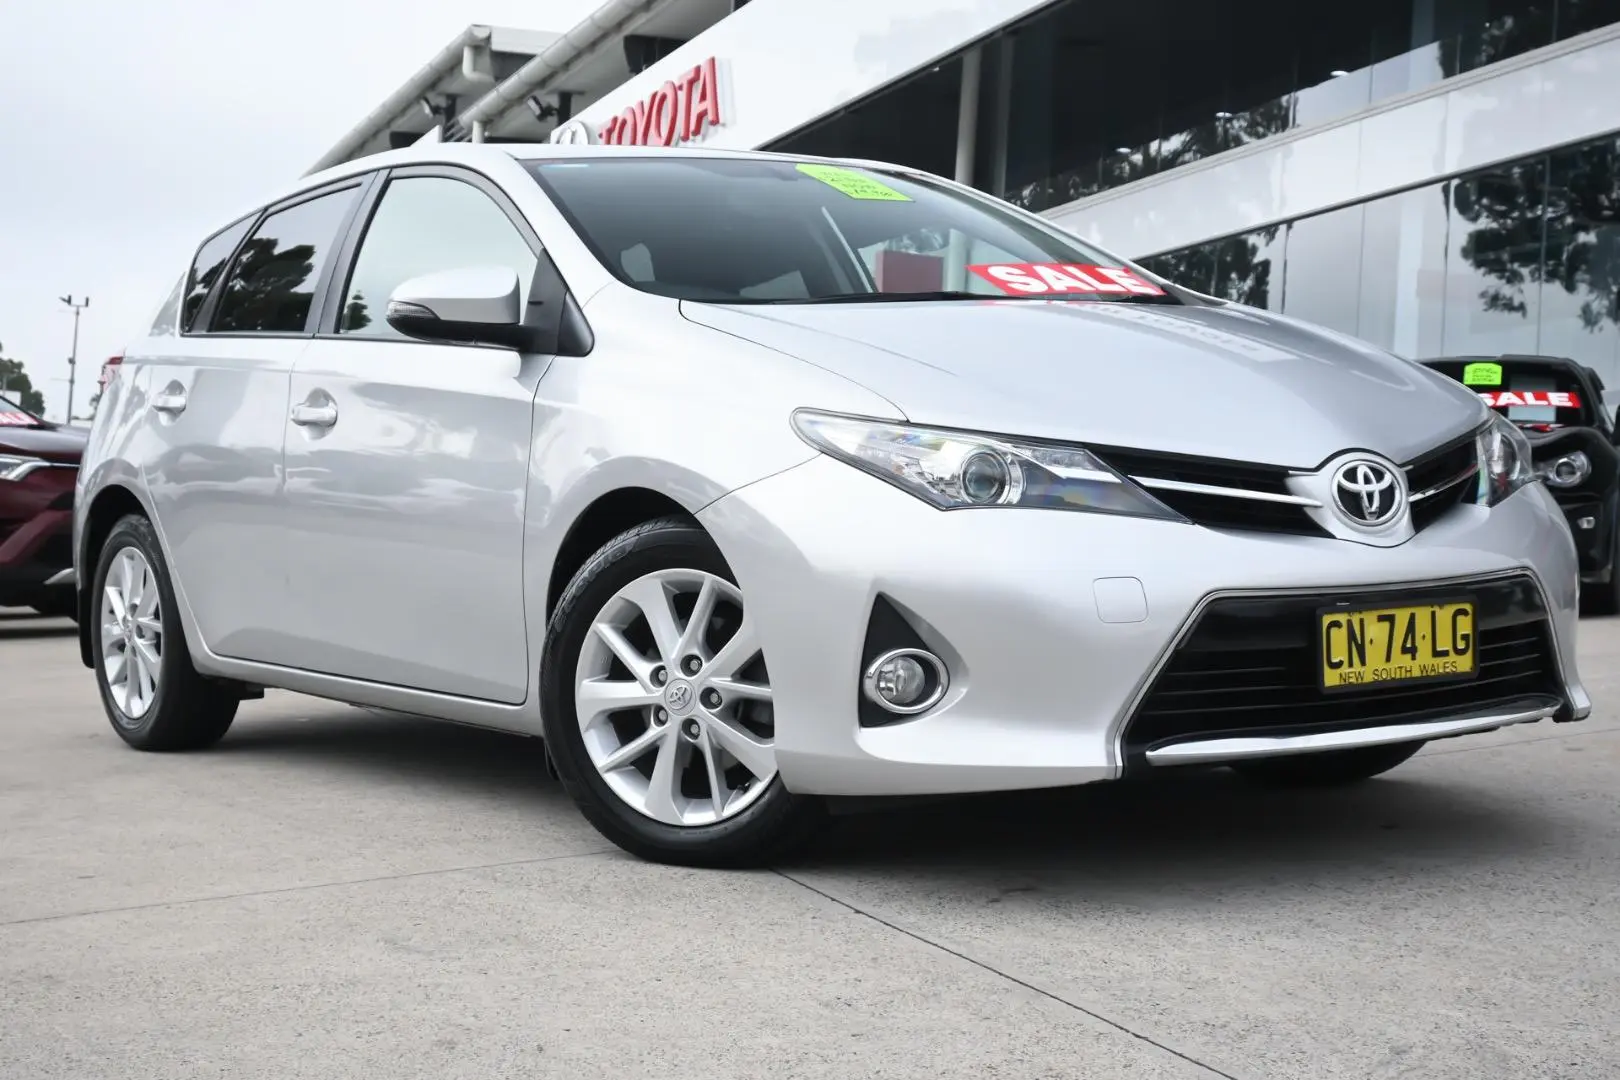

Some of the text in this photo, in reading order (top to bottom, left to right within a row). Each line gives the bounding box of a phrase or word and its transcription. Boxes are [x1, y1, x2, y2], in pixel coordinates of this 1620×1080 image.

[987, 265, 1160, 295] SALE
[1339, 660, 1458, 684] NEW SOUTH WALES
